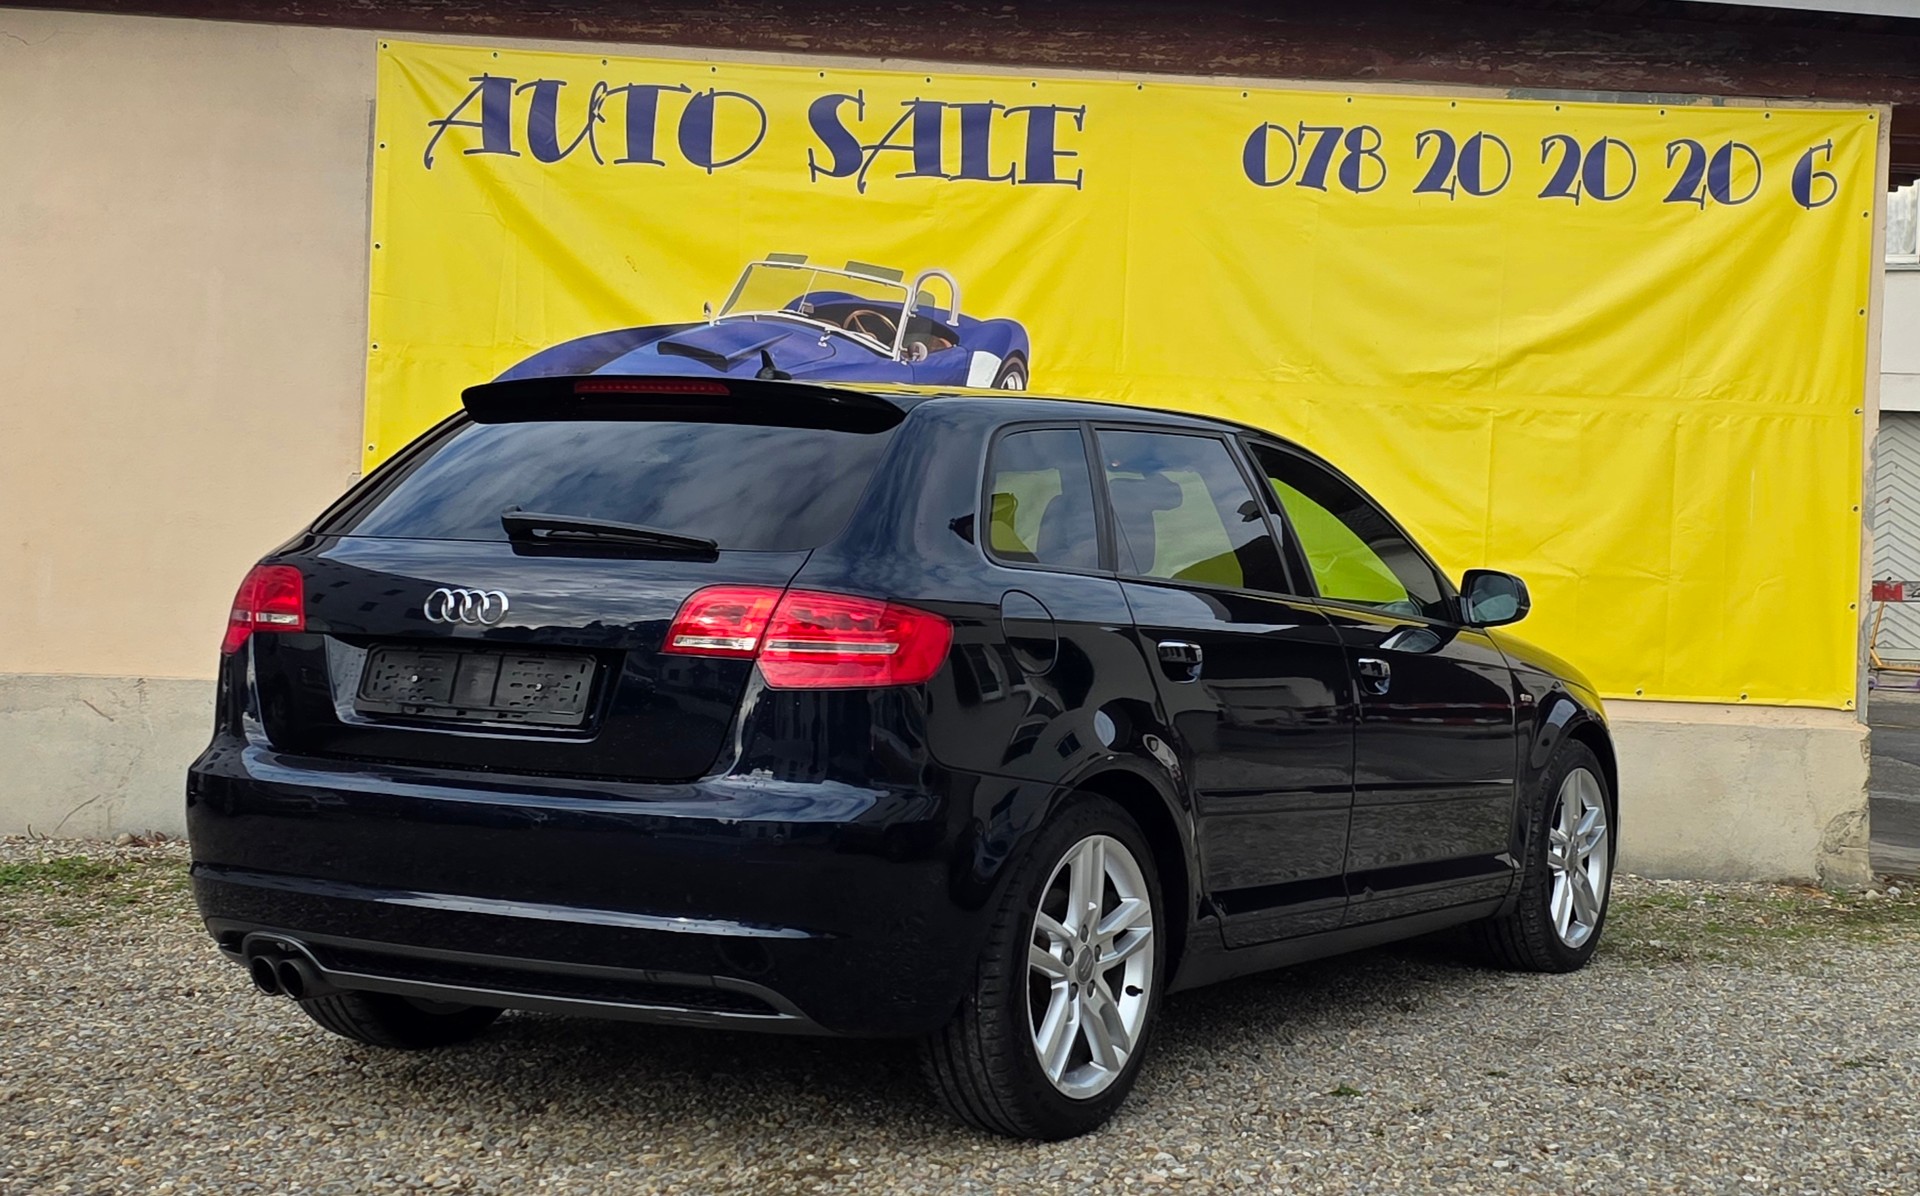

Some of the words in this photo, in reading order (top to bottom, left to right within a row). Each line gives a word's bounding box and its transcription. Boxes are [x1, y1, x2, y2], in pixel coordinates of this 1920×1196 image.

[424, 74, 767, 173] AUTO
[809, 91, 1086, 193] SALE
[1242, 121, 1387, 194] 078
[1414, 129, 1512, 201] 20
[1539, 134, 1637, 205] 20
[1664, 138, 1762, 210] 20
[1791, 139, 1838, 210] 6
